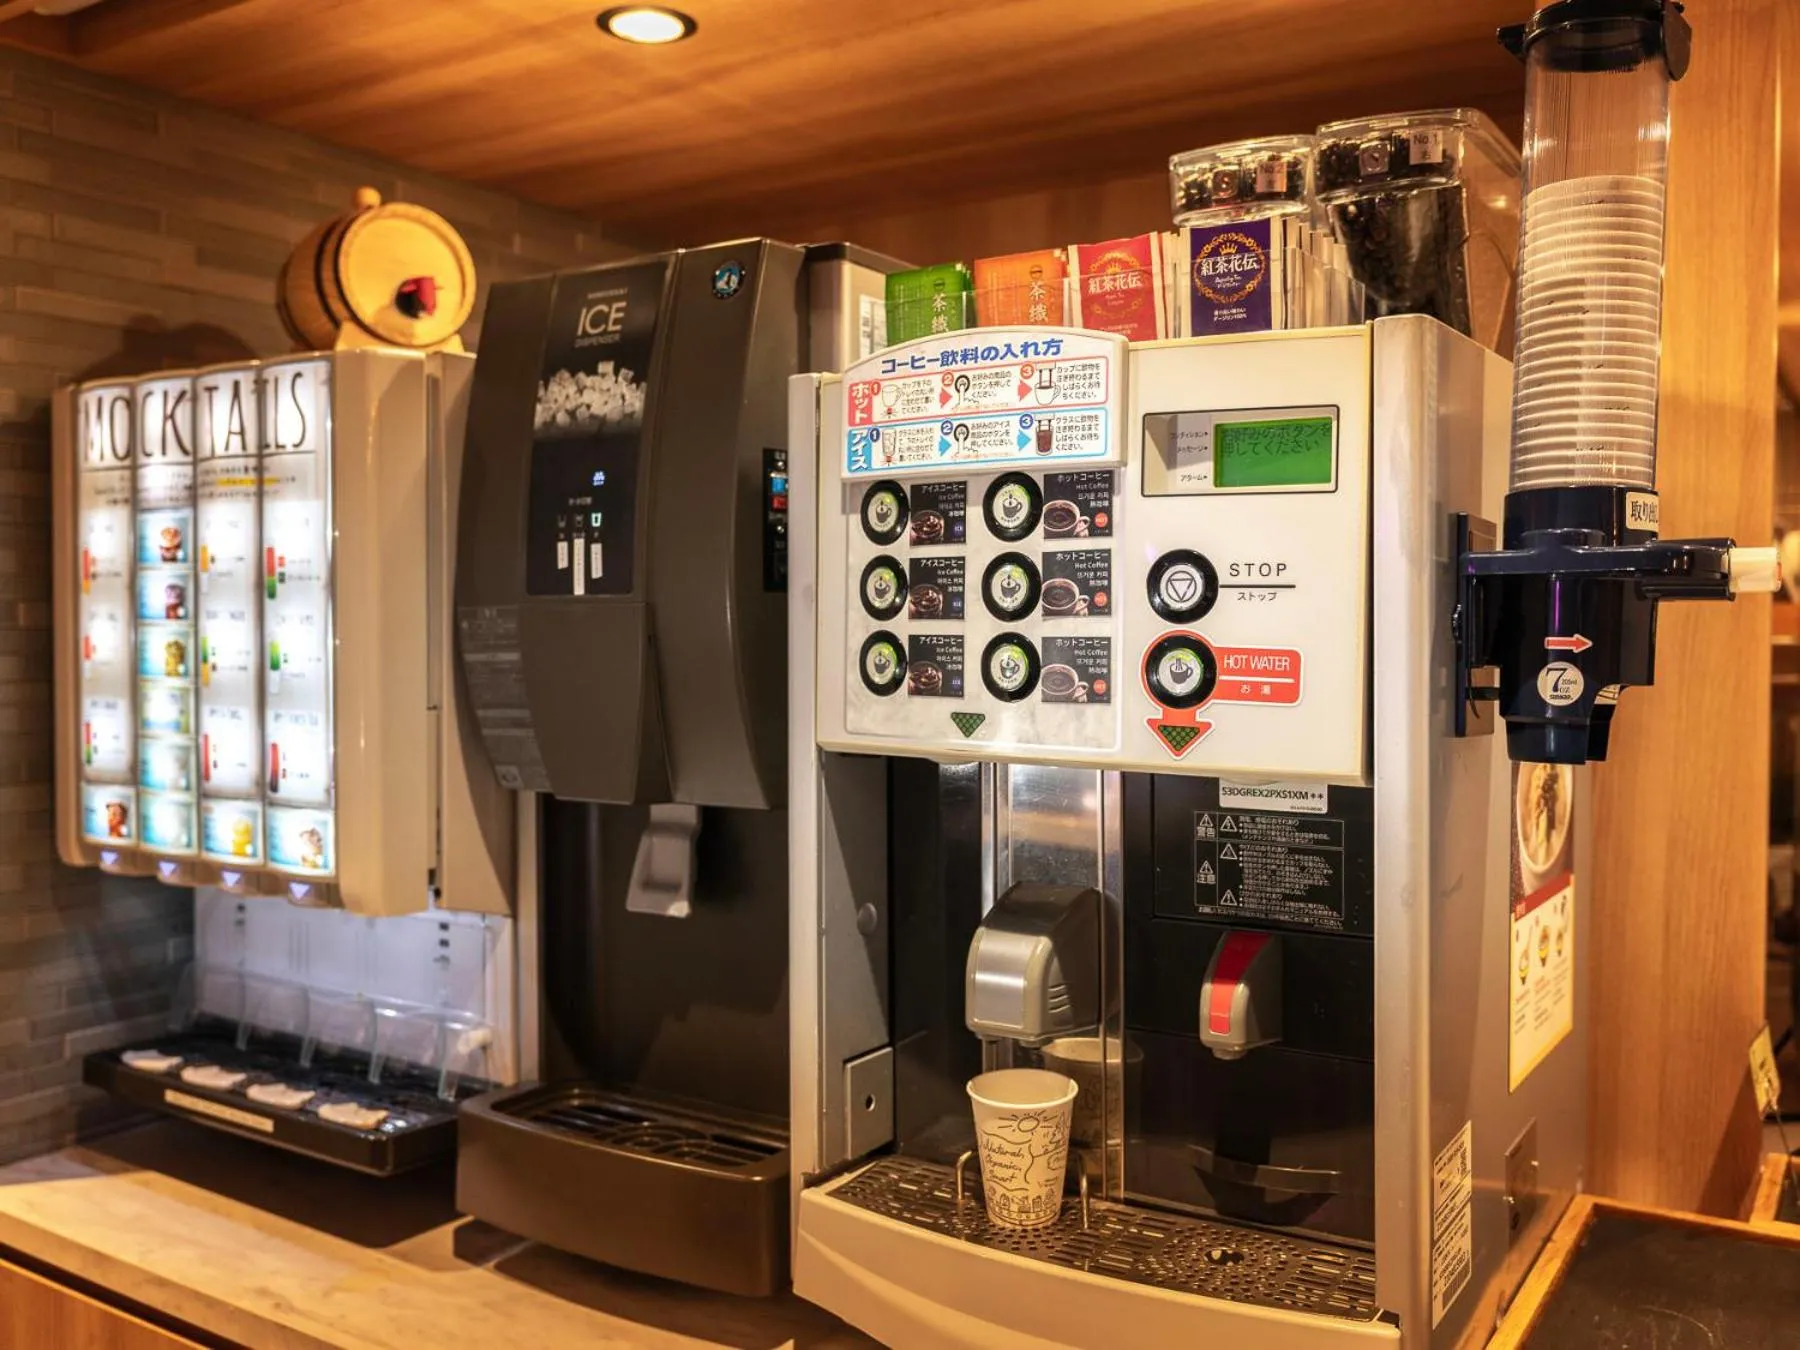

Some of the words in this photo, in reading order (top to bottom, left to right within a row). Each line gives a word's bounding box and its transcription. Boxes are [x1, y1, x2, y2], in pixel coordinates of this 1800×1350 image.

[1200, 253, 1261, 277] 紅茶花伝
[1088, 271, 1144, 296] 紅茶花伝
[577, 301, 628, 336] ICE
[881, 337, 1064, 375] コーヒー飲料の入れ方
[851, 382, 871, 424] ホット
[851, 431, 870, 471] アイス
[1057, 472, 1110, 482] ホットコーヒー
[920, 559, 965, 568] アイスコーヒー
[1056, 551, 1109, 561] ホットコーヒー
[1229, 562, 1288, 578] STOP
[1236, 591, 1278, 602] ストップ
[919, 636, 963, 645] アイスコーヒー
[1055, 638, 1109, 647] ホットコーヒー
[1223, 654, 1248, 670] HOT
[1249, 655, 1290, 672] WATER
[1545, 667, 1568, 693] 7
